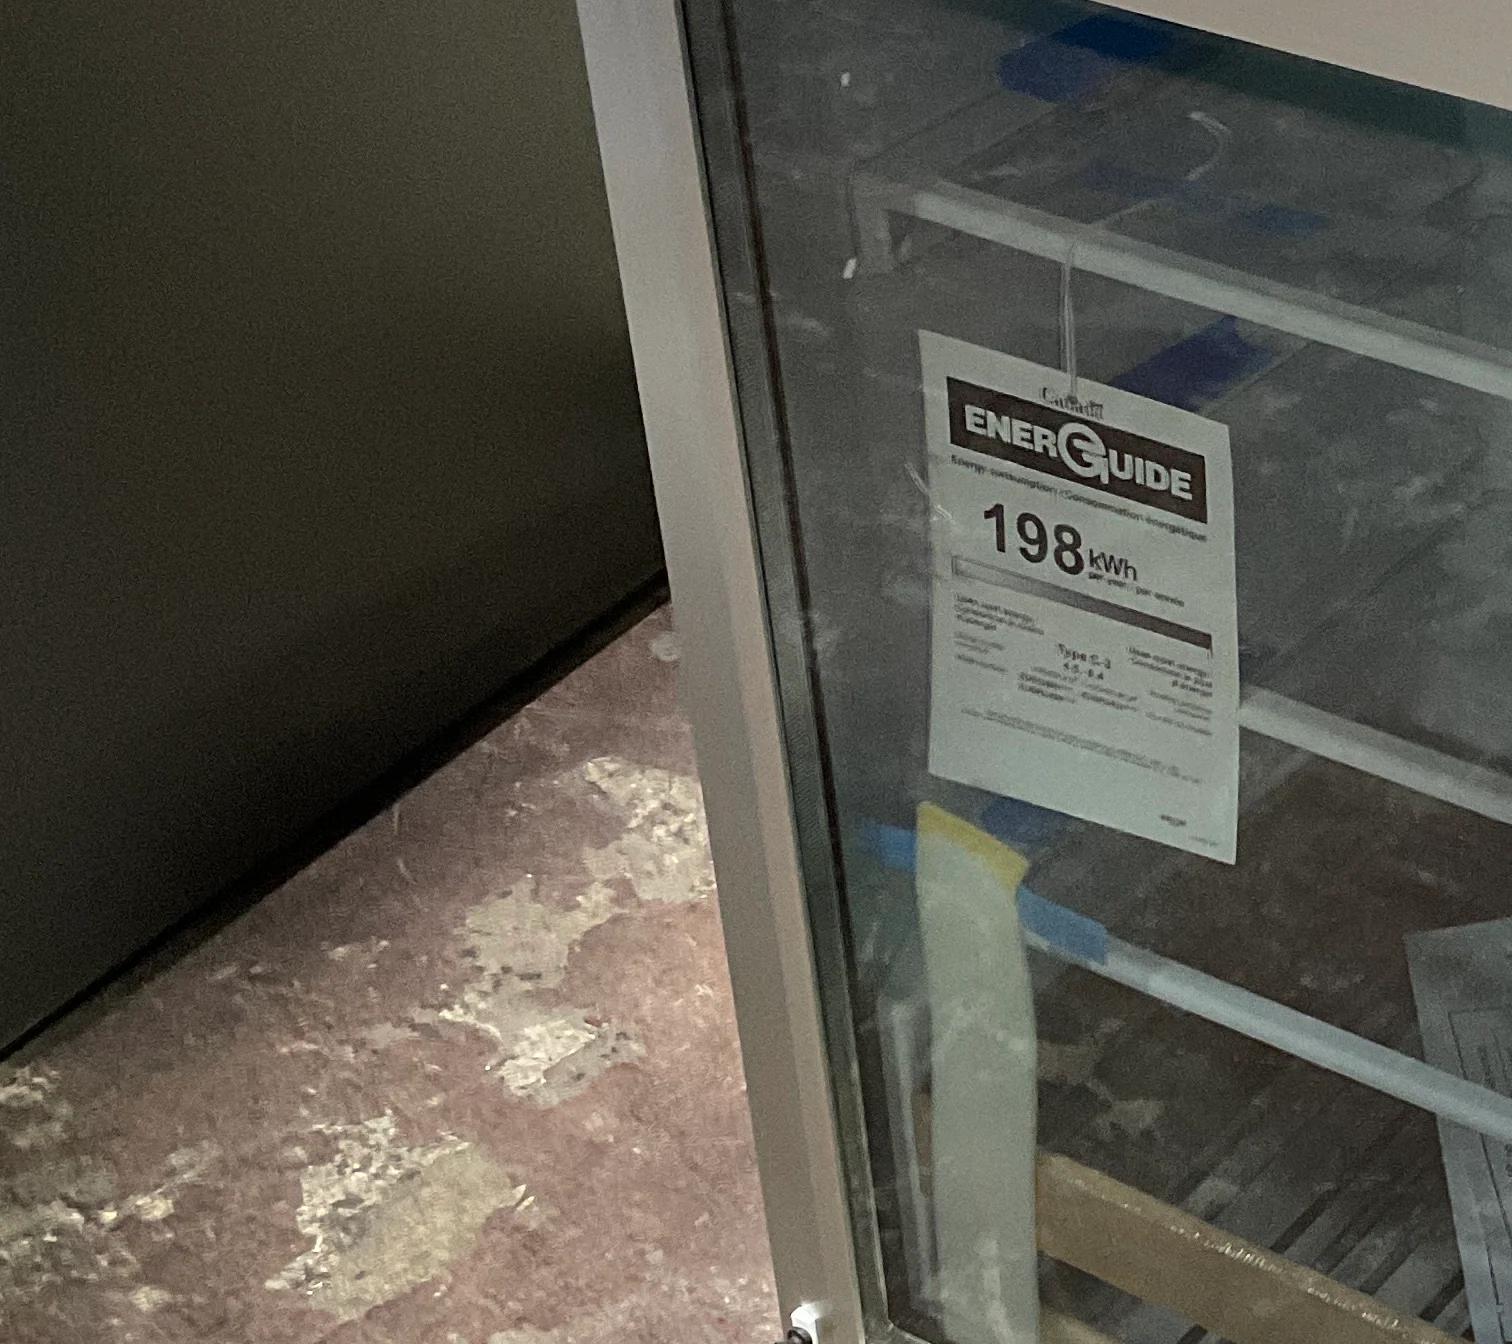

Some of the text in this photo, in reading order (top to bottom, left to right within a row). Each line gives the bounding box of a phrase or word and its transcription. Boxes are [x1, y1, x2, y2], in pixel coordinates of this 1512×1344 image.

[964, 404, 1193, 501] ENERGUIDE
[983, 503, 1138, 582] 198 kWh
